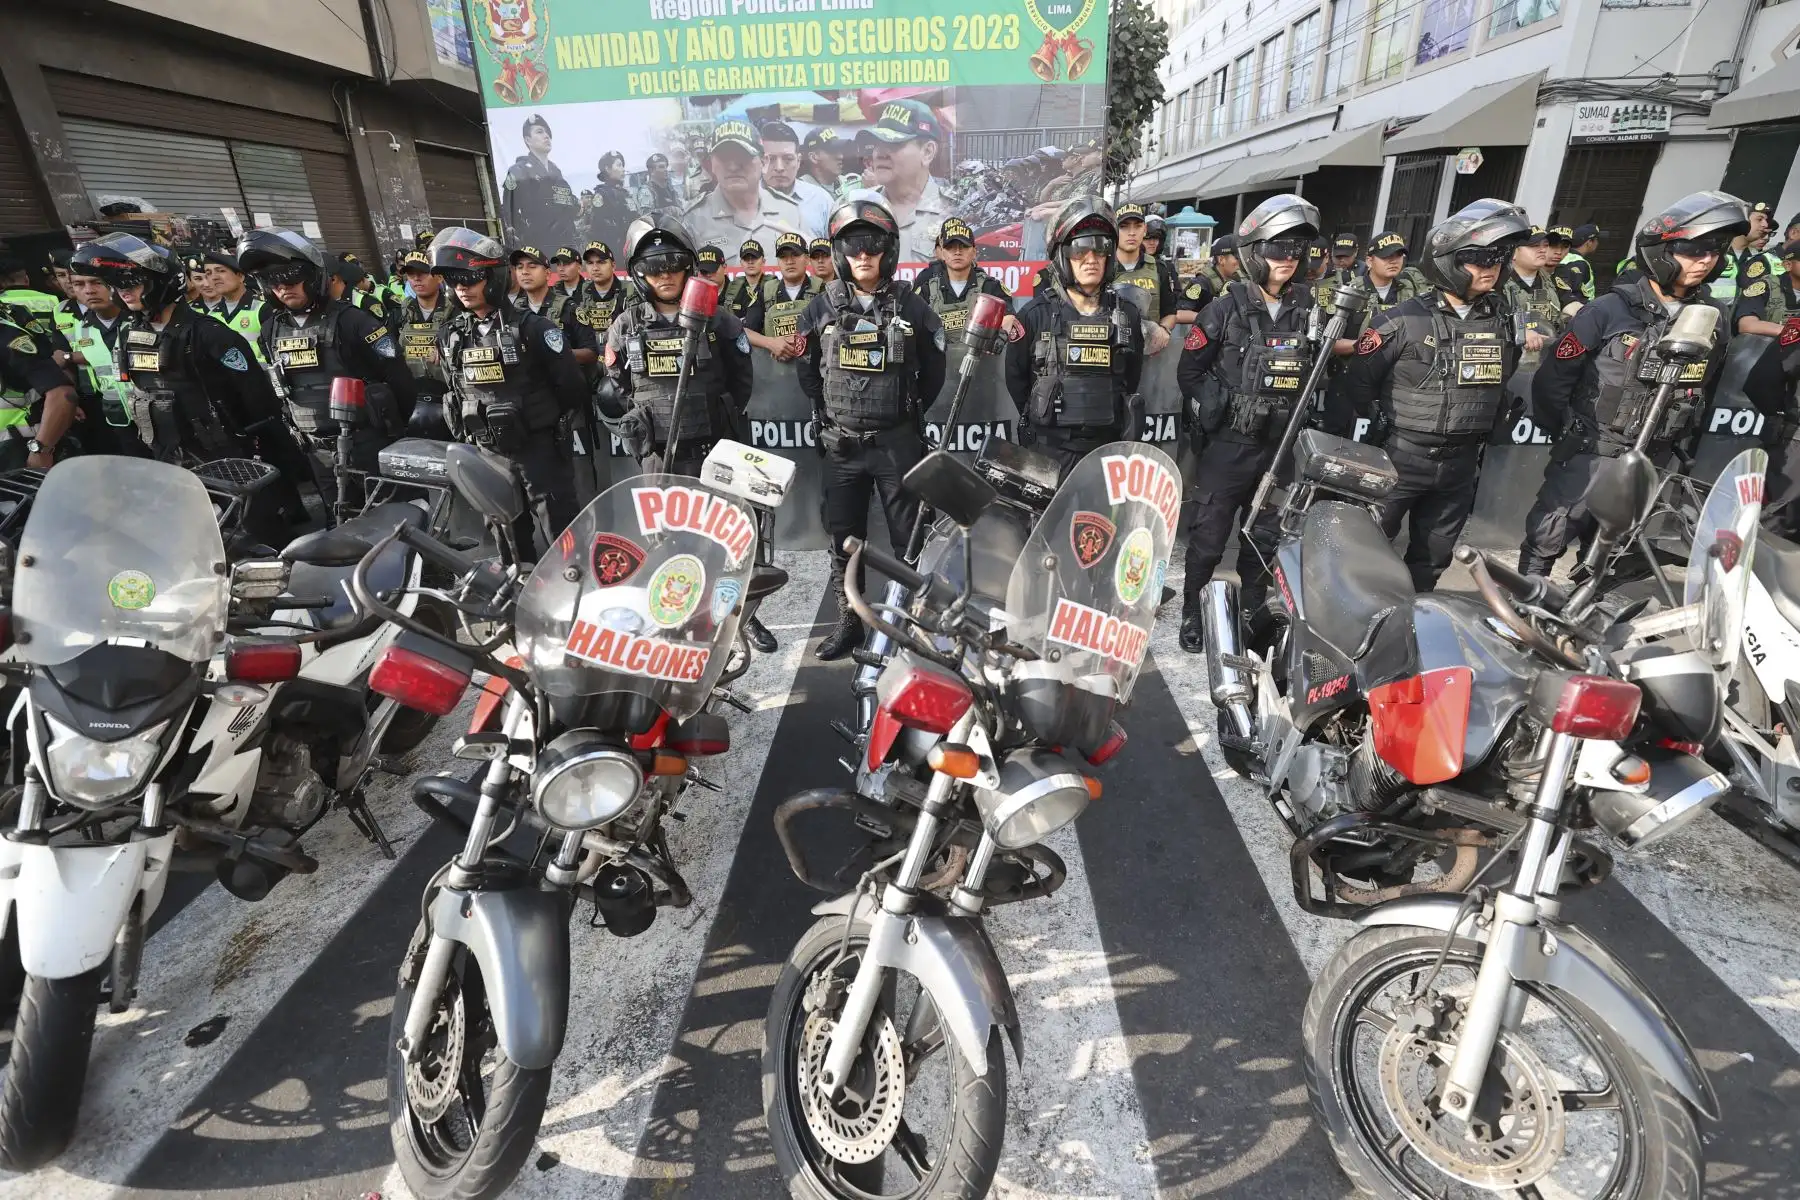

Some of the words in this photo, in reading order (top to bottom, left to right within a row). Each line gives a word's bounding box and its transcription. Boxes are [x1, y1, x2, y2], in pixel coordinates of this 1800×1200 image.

[1026, 0, 1048, 31] SERVICIO
[1047, 4, 1072, 15] LIMA
[555, 30, 660, 70] NAVIDAD
[664, 28, 679, 63] Y
[686, 20, 736, 62] AÑO
[740, 18, 822, 60] NUEVO
[829, 15, 947, 54] SEGUROS
[952, 13, 1020, 51] 2023
[628, 65, 700, 96] POLICÍA
[703, 63, 808, 92] GARANTIZA
[812, 61, 837, 86] TU
[840, 58, 950, 85] SEGURIDAD
[880, 104, 911, 126] LICIA
[1579, 105, 1609, 119] SUMAQ
[715, 124, 752, 141] POLICIA
[1115, 204, 1144, 217] POLICIA
[946, 226, 970, 239] POLICIA
[775, 325, 797, 337] POLIC
[650, 356, 676, 372] HALCONES
[842, 347, 868, 367] HALCONES
[1080, 347, 1109, 364] HALCONES
[751, 421, 816, 448] POLIC
[925, 423, 1008, 451] OLICIA
[1107, 459, 1180, 538] POLICIA
[637, 490, 754, 563] POLICIA
[1274, 566, 1296, 614] POLICIA
[1052, 602, 1148, 664] HALCONES
[566, 620, 709, 681] HALCONES
[231, 712, 265, 742] HONDA
